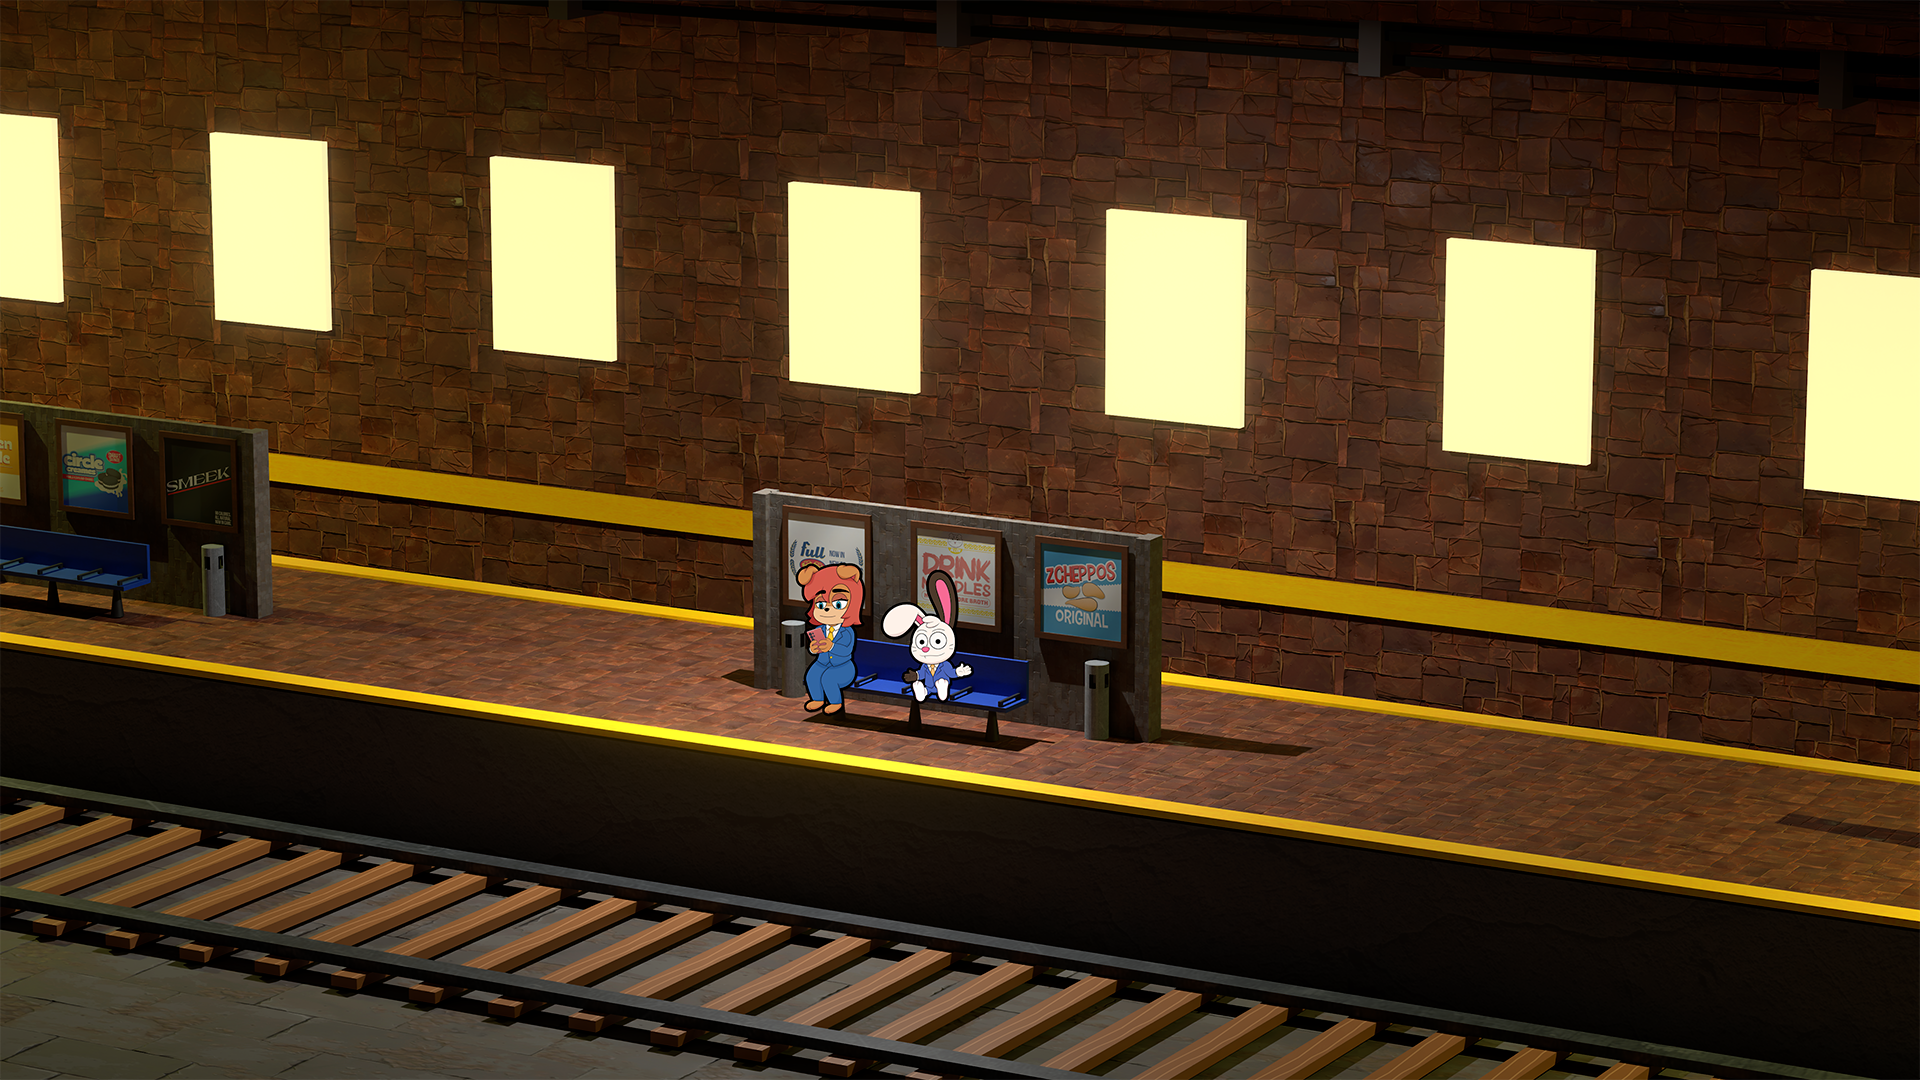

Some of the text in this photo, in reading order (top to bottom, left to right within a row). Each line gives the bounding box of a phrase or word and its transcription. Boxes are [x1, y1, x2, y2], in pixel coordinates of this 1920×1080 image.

[63, 452, 104, 470] circle
[166, 466, 230, 492] SMEEK
[800, 541, 826, 558] full
[829, 550, 839, 558] NOW
[922, 552, 991, 583] DRINK
[1045, 561, 1116, 584] ZCHEPPOS
[922, 576, 991, 597] DLES
[1055, 609, 1108, 629] ORIGINAL
